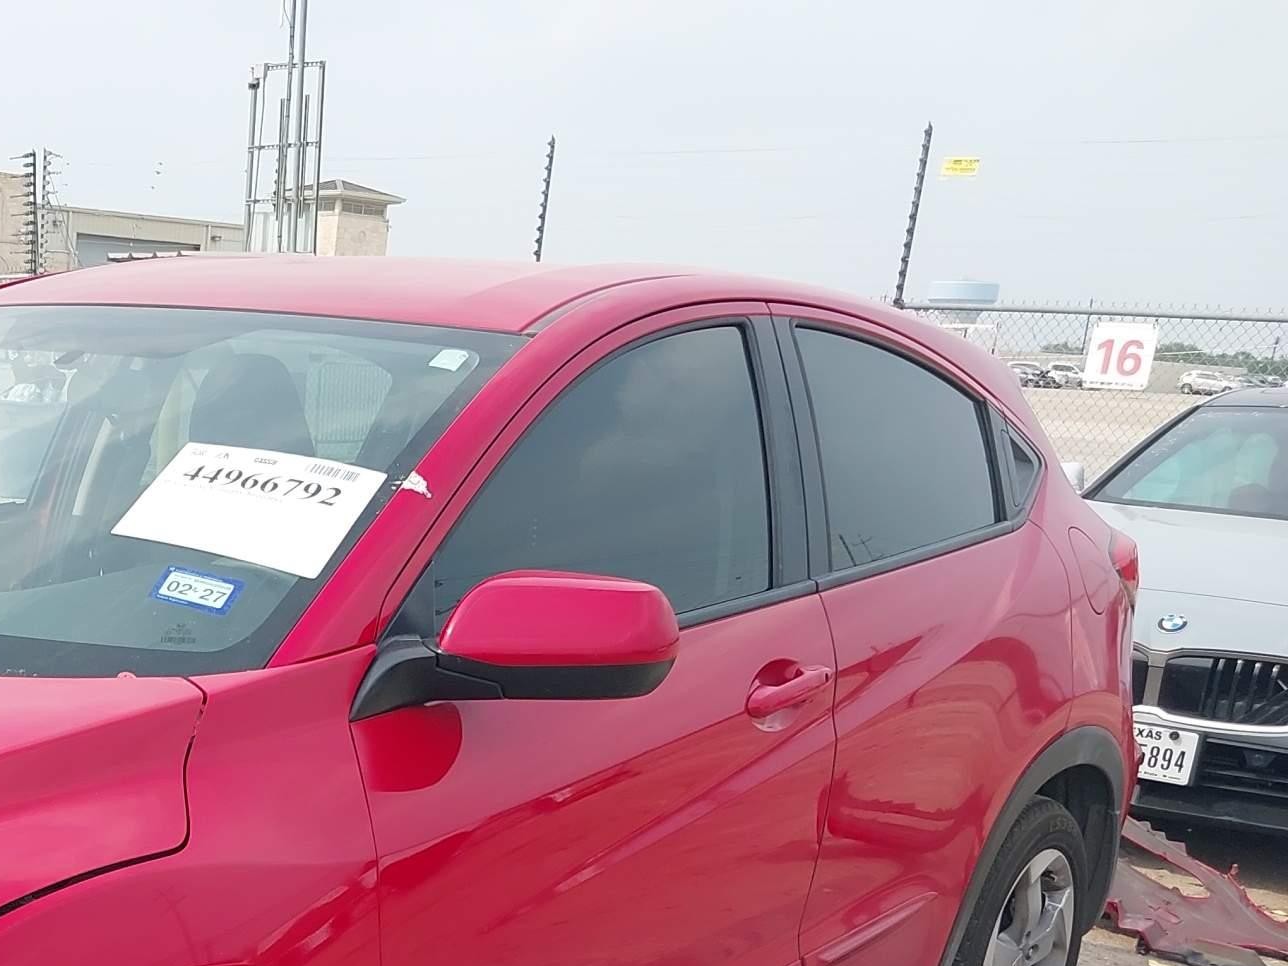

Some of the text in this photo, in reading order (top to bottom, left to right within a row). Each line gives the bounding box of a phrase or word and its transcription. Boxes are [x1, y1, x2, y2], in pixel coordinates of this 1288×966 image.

[1097, 339, 1145, 376] 16
[183, 464, 343, 507] 44966792
[1133, 727, 1162, 741] XAS
